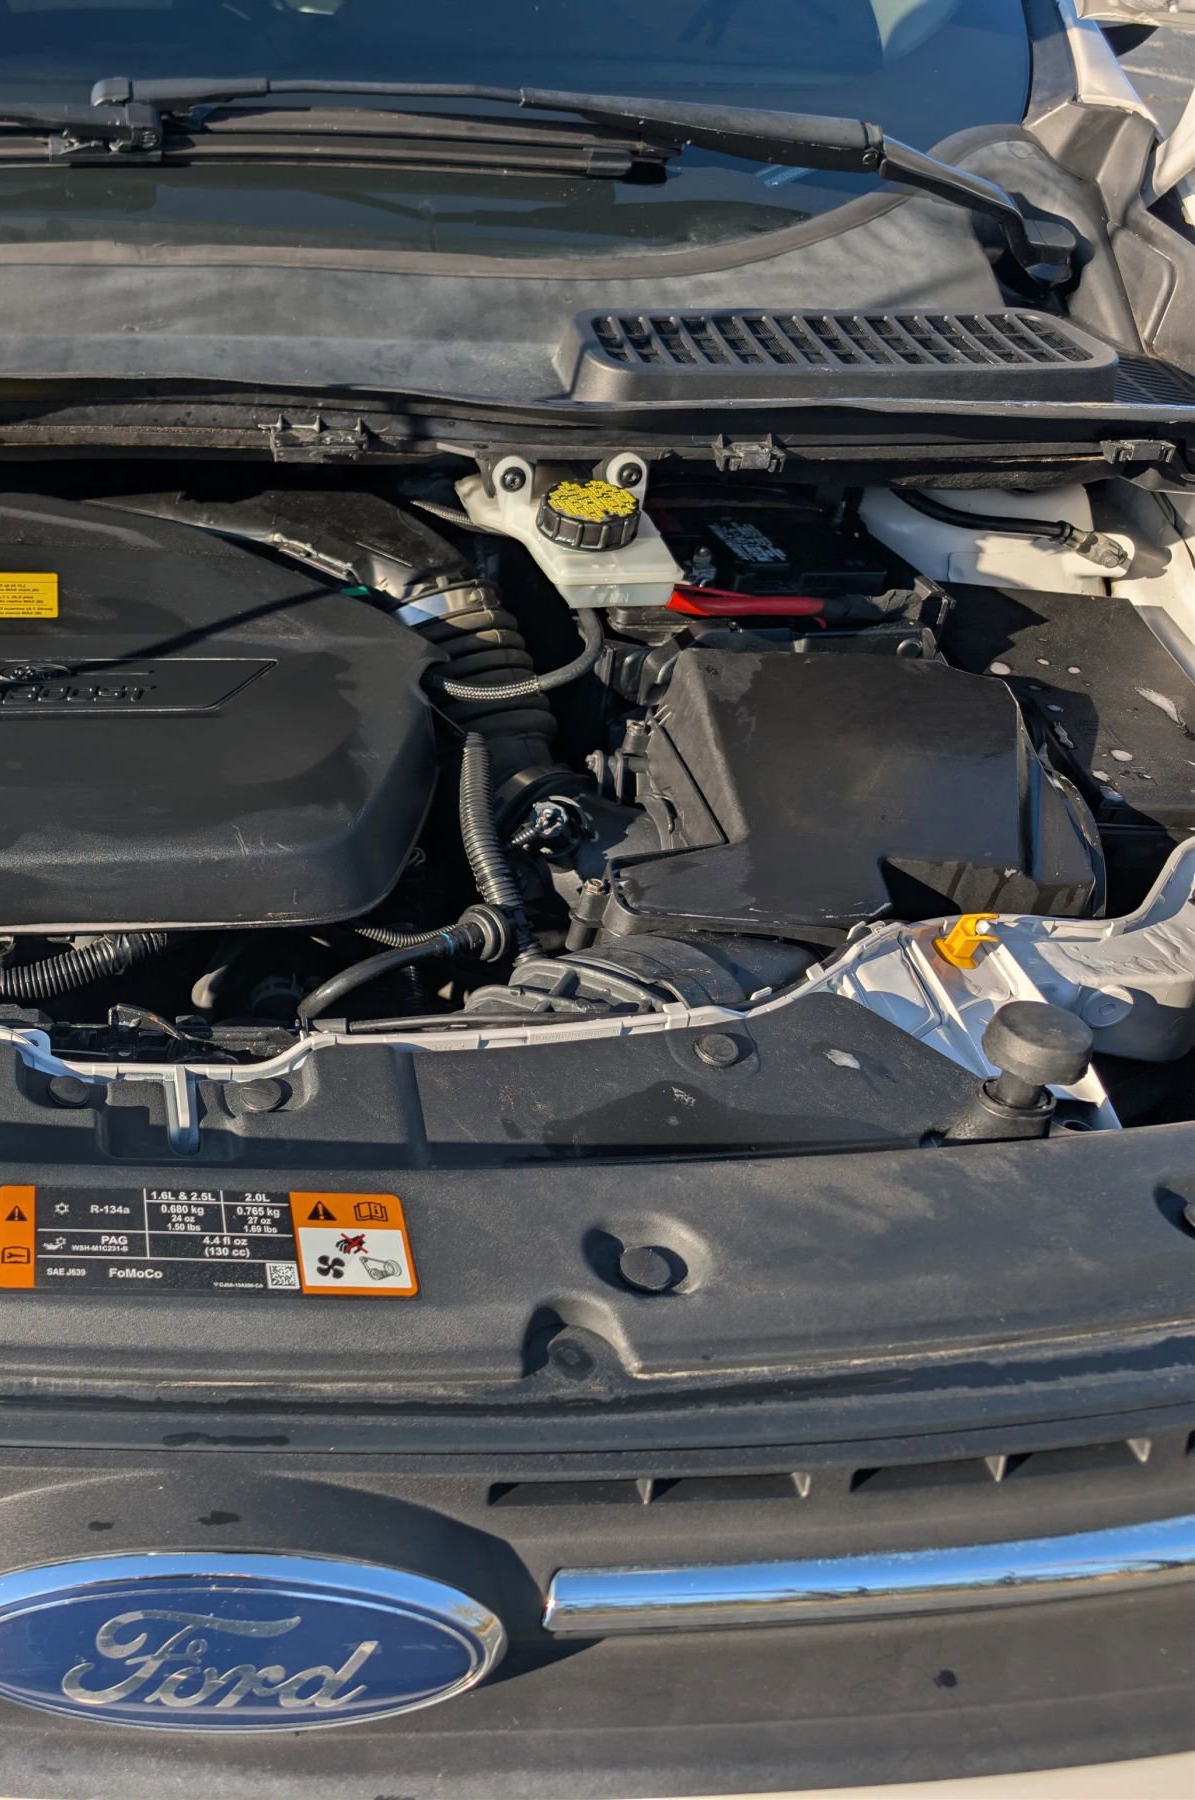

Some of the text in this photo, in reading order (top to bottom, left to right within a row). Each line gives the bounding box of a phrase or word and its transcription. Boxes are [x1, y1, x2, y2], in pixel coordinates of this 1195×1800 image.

[150, 1191, 216, 1201] 1.6L & 2.5L
[244, 1193, 271, 1202] 2.0L
[90, 1204, 131, 1214] R-134a
[160, 1204, 205, 1216] 0.680 kg
[236, 1206, 280, 1218] 0.765 kg
[171, 1214, 183, 1222] 24
[247, 1216, 260, 1225] 27
[166, 1223, 201, 1231] 1.50 lbs
[243, 1225, 278, 1233] 1.69 lbs
[100, 1235, 129, 1245] PAG
[202, 1236, 249, 1246] 4.4 fl oz
[204, 1246, 251, 1257] (130 cc)
[46, 1267, 86, 1277] SAE J639
[108, 1267, 163, 1279] FoMoCo
[60, 1608, 379, 1709] Ford
